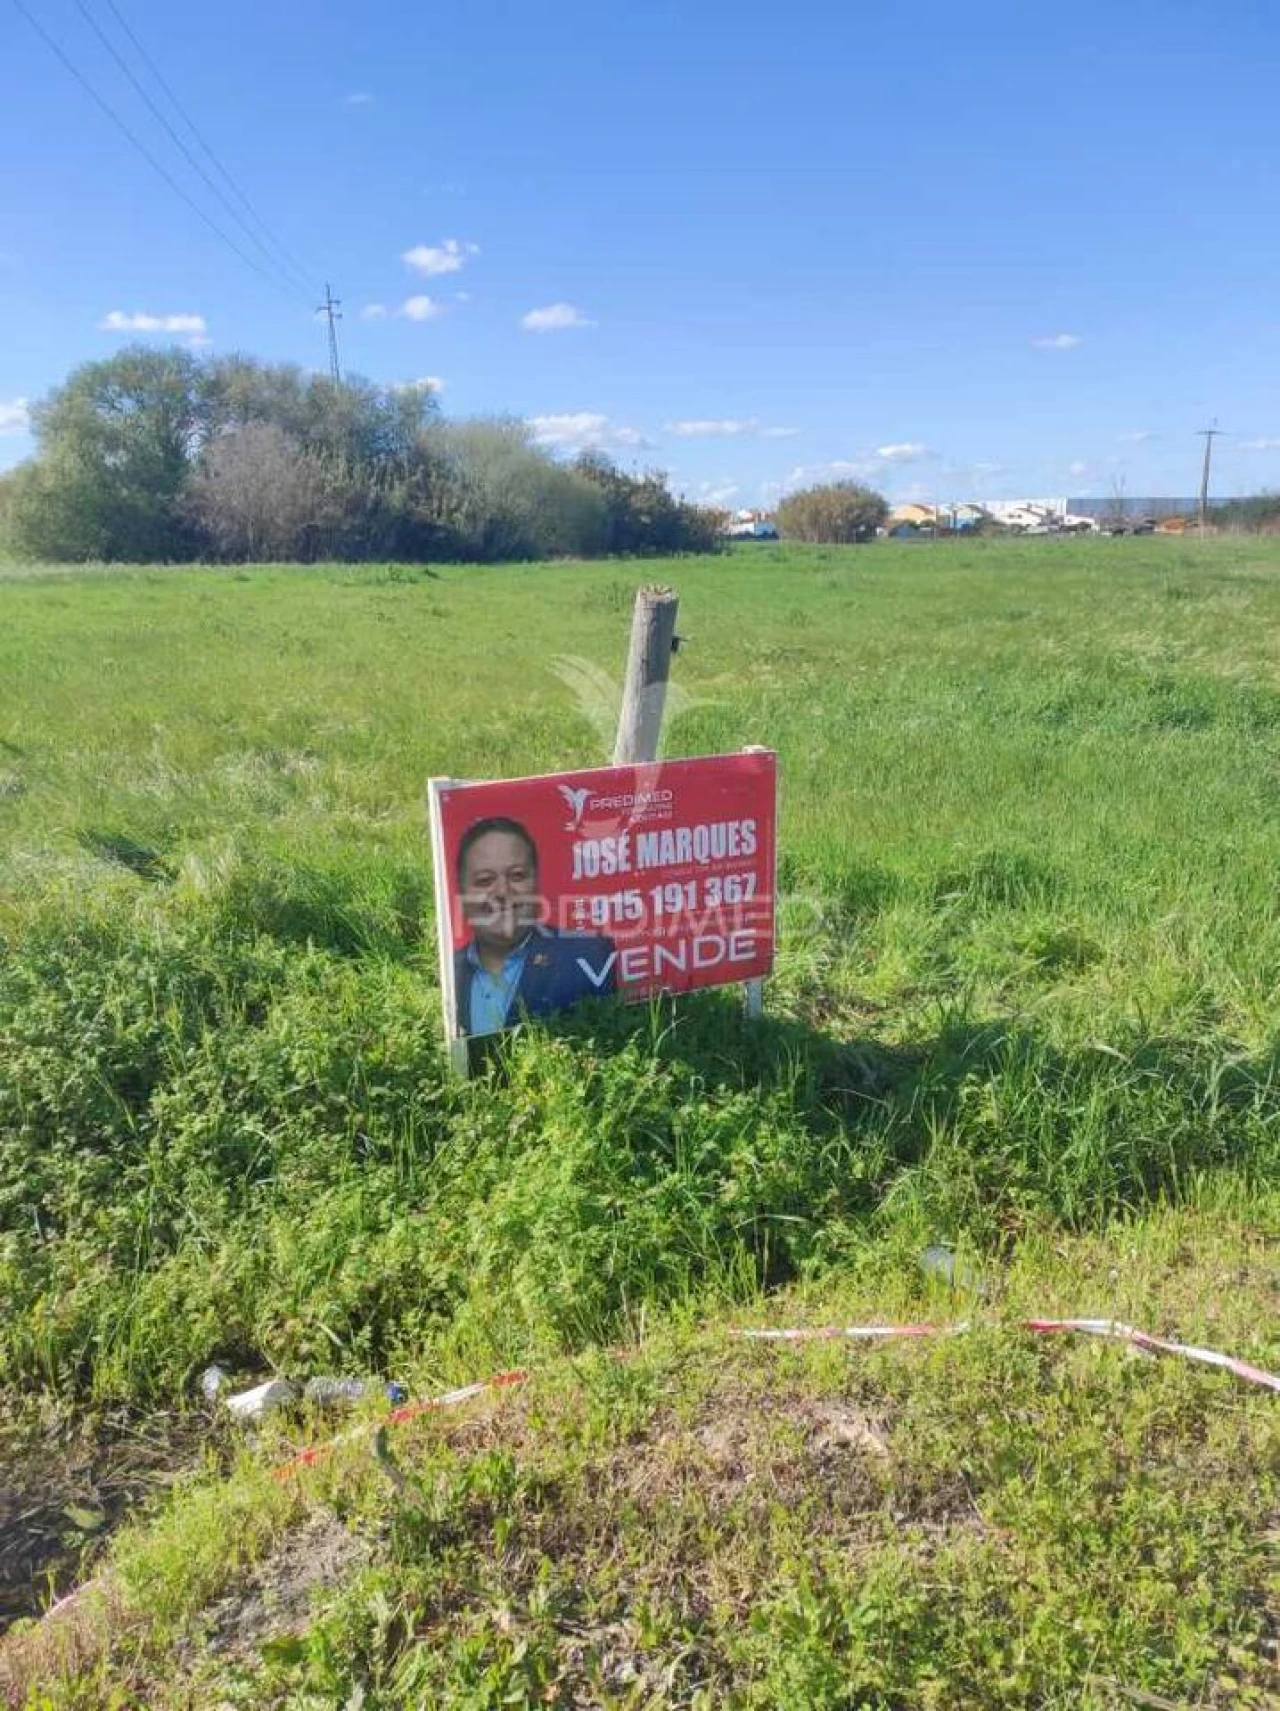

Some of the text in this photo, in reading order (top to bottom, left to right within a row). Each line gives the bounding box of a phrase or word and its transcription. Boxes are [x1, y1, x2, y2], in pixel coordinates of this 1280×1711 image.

[589, 789, 673, 811] PREDIMED
[572, 819, 757, 880] JOSÉ MARQUES
[592, 888, 643, 926] 915
[650, 880, 698, 916] 191
[705, 872, 757, 907] 367
[576, 929, 757, 987] VENDE
